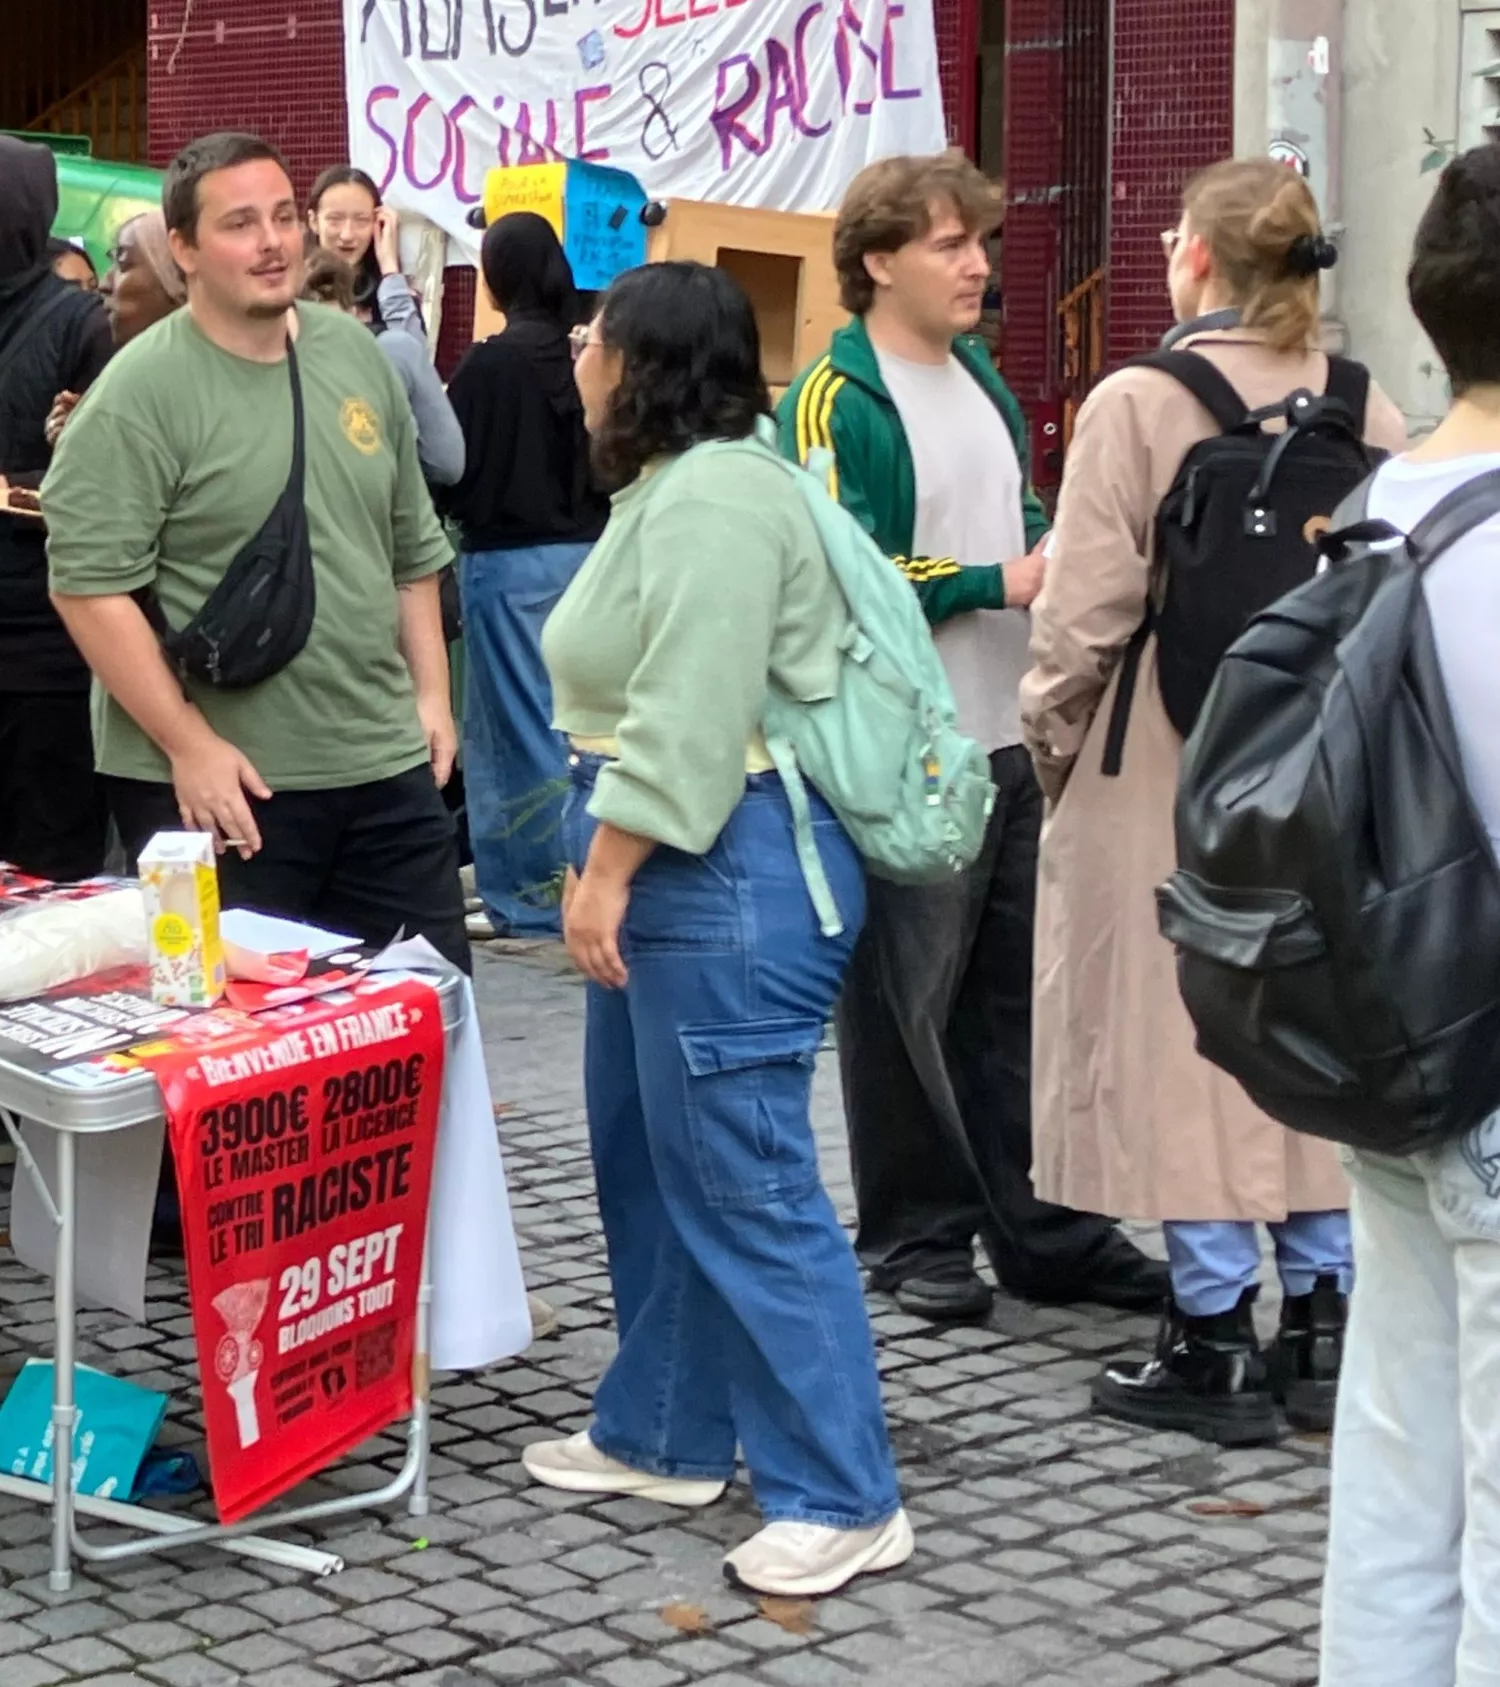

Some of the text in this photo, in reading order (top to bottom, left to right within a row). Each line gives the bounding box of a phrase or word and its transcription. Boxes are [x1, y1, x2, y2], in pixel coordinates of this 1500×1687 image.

[638, 61, 681, 161] &
[709, 0, 922, 171] RACISE
[197, 1029, 312, 1087] BIENVENUE
[306, 1021, 338, 1058] EN
[334, 1002, 410, 1051] FRANCE
[199, 1053, 425, 1157] 3900€ 2800€
[204, 1098, 418, 1190] LE MASTER LA LICENCE
[207, 1191, 264, 1231] CONTRE
[209, 1142, 414, 1267] LE TRI RACISTE
[277, 1223, 404, 1321] 29 SEPT
[278, 1278, 397, 1355] BLOQUONS TOUT
